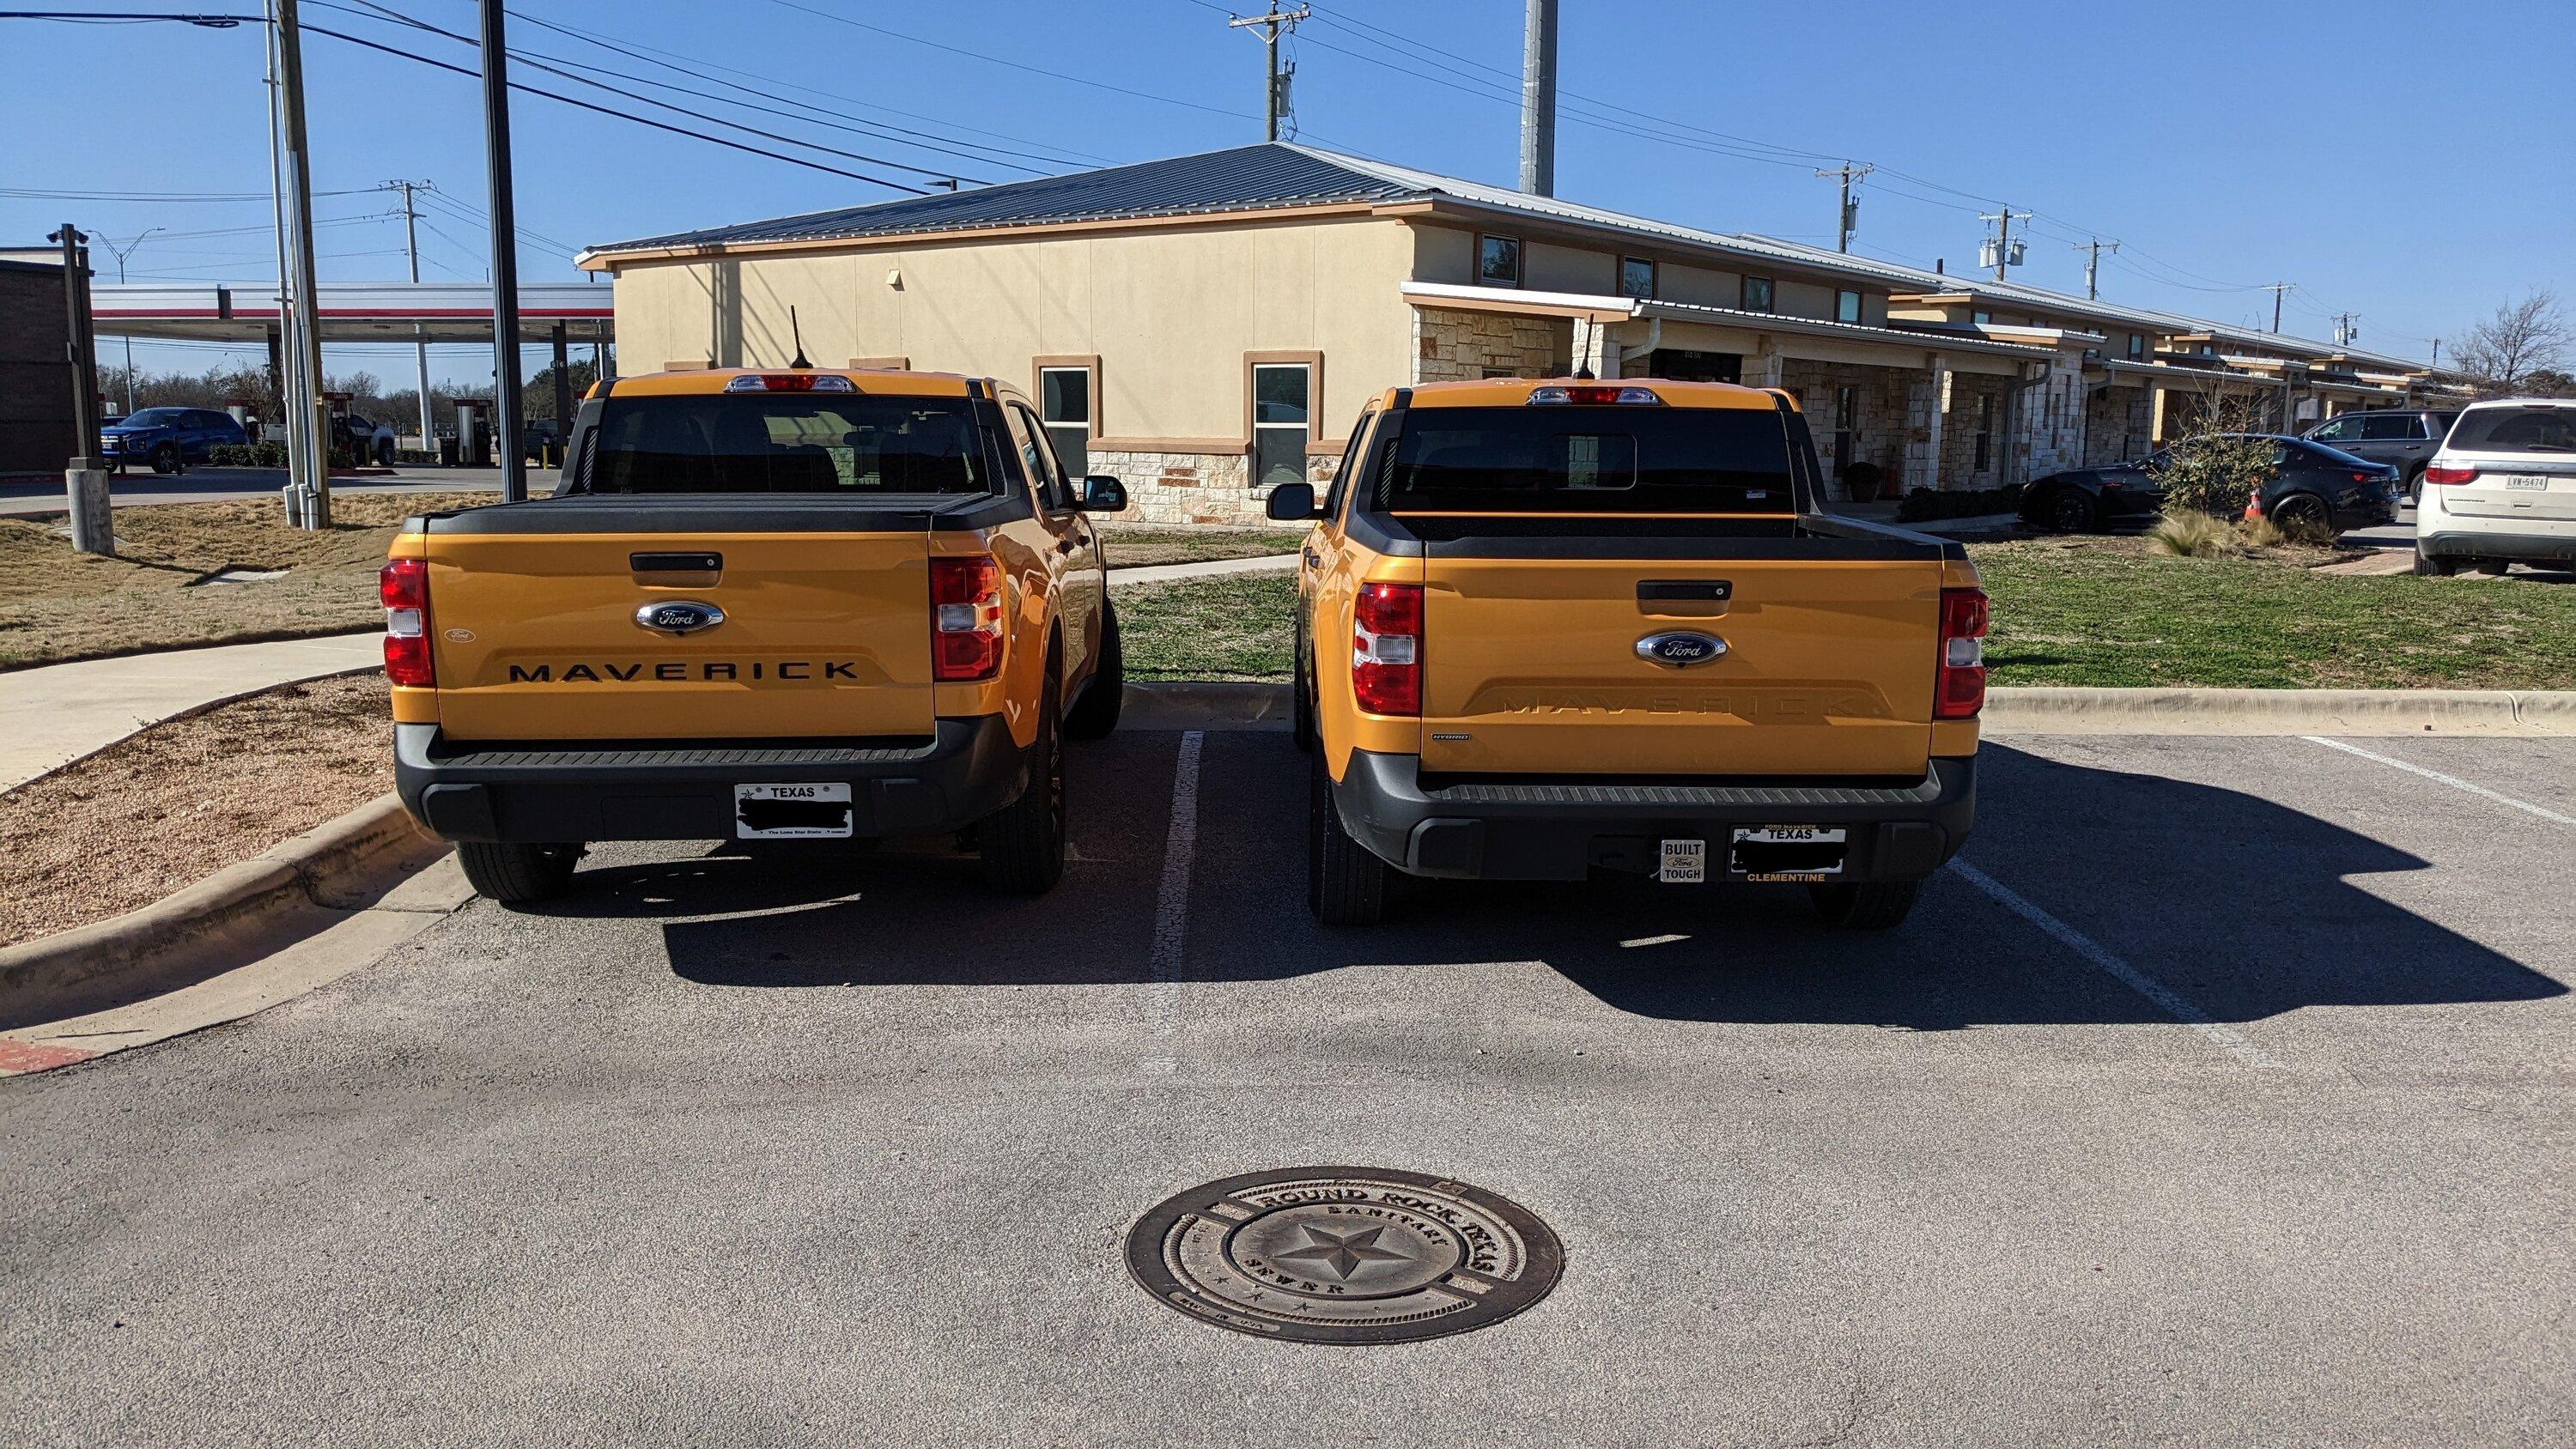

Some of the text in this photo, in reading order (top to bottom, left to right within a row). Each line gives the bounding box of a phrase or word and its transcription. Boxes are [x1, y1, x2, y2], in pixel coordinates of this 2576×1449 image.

[659, 609, 696, 625] Ford
[1665, 640, 1702, 657] Ford
[509, 662, 858, 683] MAVERICK
[1504, 696, 1856, 715] MAVERICK
[771, 787, 815, 797] TEXAS
[1769, 829, 1813, 840] TEXAS
[1665, 844, 1701, 855] BUILT
[1672, 858, 1693, 867] Ford
[1664, 870, 1700, 879] TOUGH
[1747, 873, 1826, 882] CLEMENTINE
[1255, 1188, 1499, 1272] ROUND ROCK TEXAS
[1327, 1205, 1449, 1246] SANITARY
[1244, 1258, 1345, 1294] SEWER
